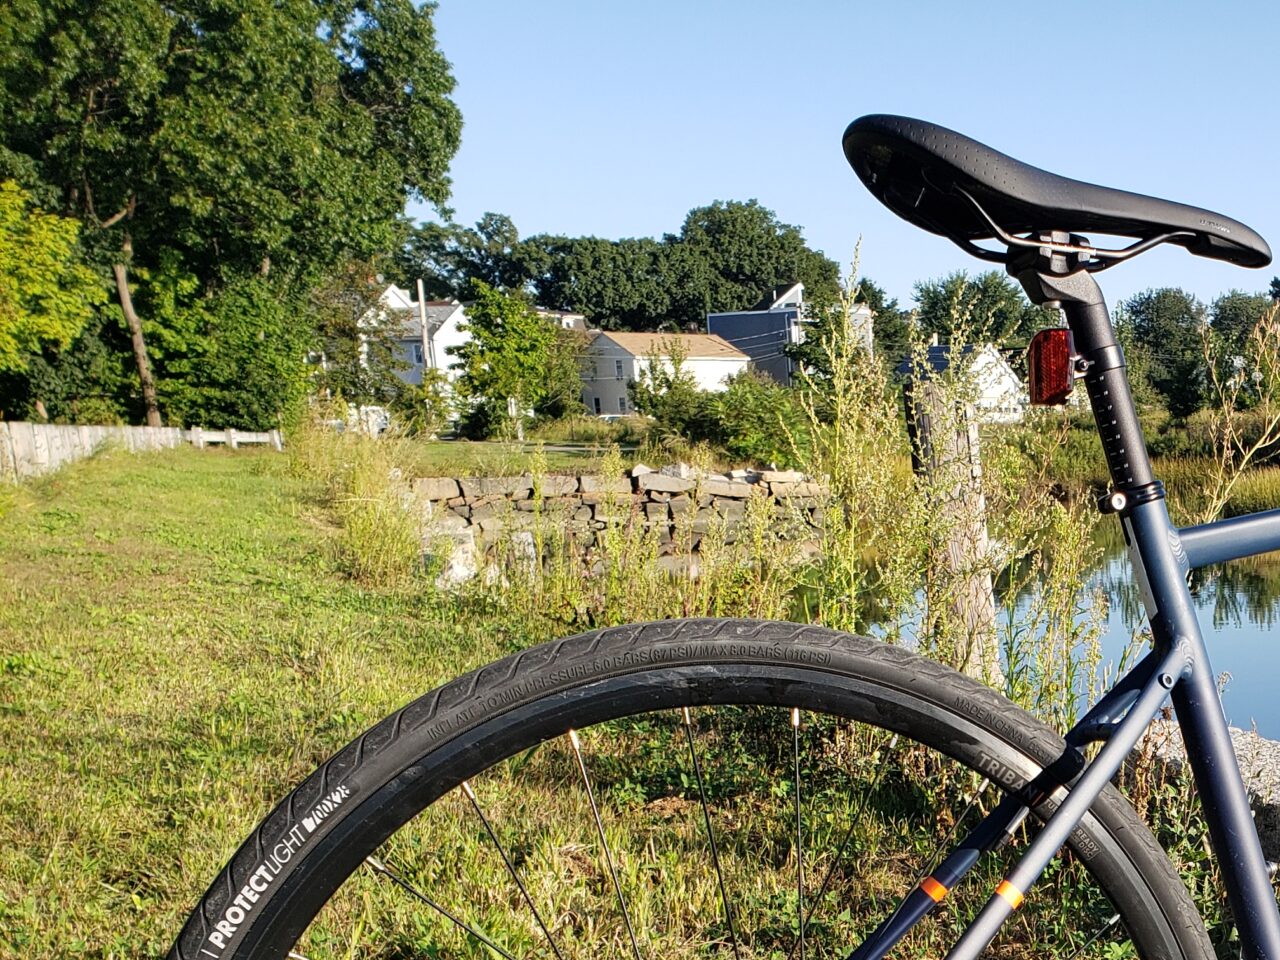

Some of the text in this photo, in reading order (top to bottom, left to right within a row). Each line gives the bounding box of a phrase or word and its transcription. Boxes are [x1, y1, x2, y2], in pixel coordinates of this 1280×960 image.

[427, 707, 475, 740] INFLATE
[481, 696, 499, 712] TO
[500, 686, 523, 706] MIN
[525, 662, 593, 694] PRESSURE
[613, 650, 649, 668] BARS
[750, 645, 781, 658] BARS
[809, 650, 832, 666] PSI)
[954, 696, 1024, 744] MADE IN CHINA
[1076, 826, 1099, 853] READY
[1078, 841, 1095, 859] DISC
[208, 824, 306, 950] PROTECTLIGHT
